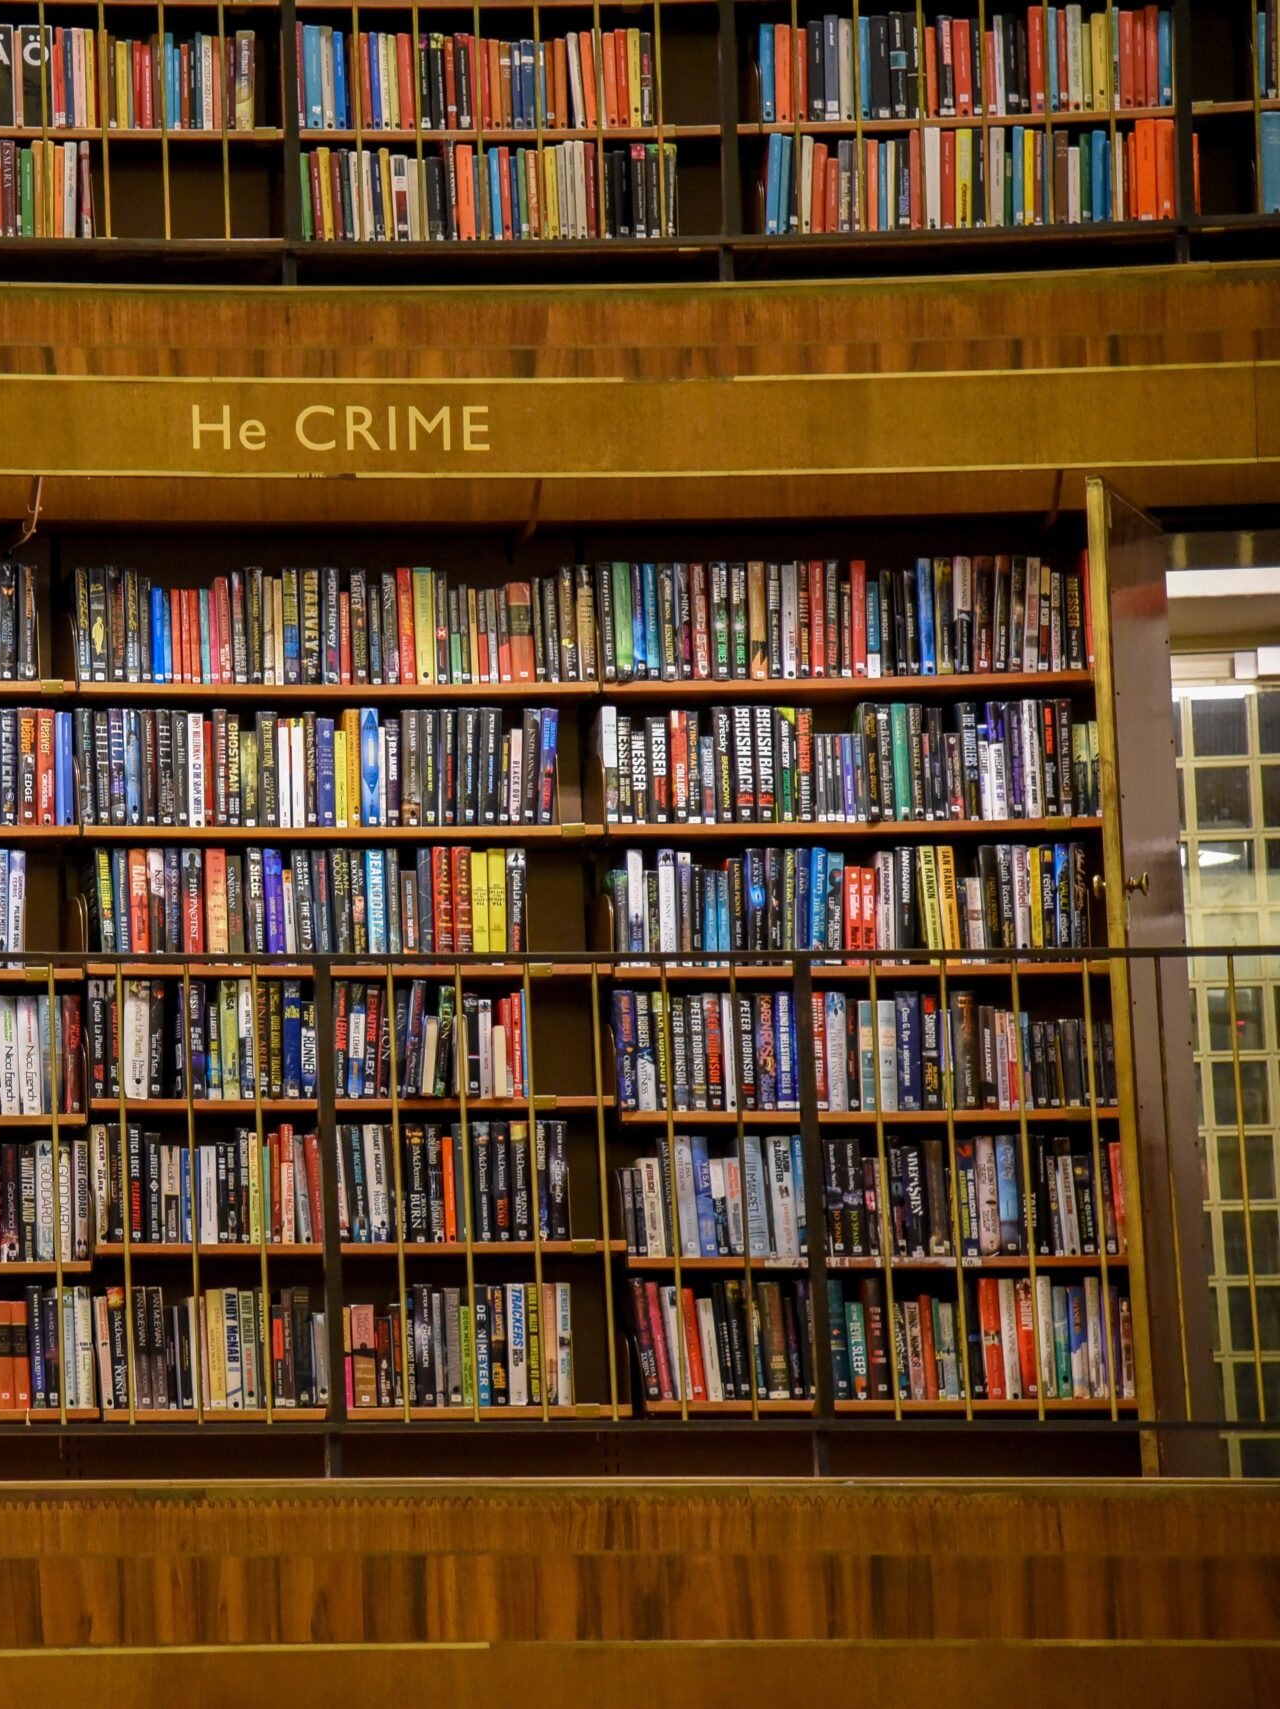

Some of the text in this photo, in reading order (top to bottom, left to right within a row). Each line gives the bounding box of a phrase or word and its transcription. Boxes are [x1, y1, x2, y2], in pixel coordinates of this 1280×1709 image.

[23, 34, 50, 66] Ö
[191, 404, 491, 451] He CRIME
[350, 574, 362, 609] HARVEY
[681, 593, 690, 622] MINA
[328, 578, 337, 647] John Harvey
[21, 718, 32, 753] Deaver
[40, 718, 51, 755] Deaver
[159, 725, 169, 768] HILL
[652, 730, 665, 776] NESSER
[757, 708, 773, 792] BRUSH BACK
[782, 738, 790, 768] PARETSKY
[964, 714, 976, 766] THE TRAVELERS
[229, 723, 239, 792] GHOSTMAN
[512, 760, 520, 787] BLACK
[632, 741, 645, 790] NESSER
[676, 763, 685, 807] COLLUSION
[721, 756, 730, 808] BREAKDOWN
[133, 865, 146, 896] RAGE
[250, 864, 260, 897] SIEGE
[333, 853, 343, 895] KOONTZ
[944, 868, 953, 899] RANKIN
[1043, 874, 1052, 909] rendell
[190, 884, 198, 939] HYPNOTIST
[300, 901, 310, 940] THE CITY
[93, 1001, 103, 1058] Lynda La Plante
[336, 1017, 347, 1050] LEHANE
[740, 1000, 754, 1084] PETER ROBINSON
[925, 1015, 936, 1048] SANDFORD
[303, 1036, 314, 1075] RUNNER
[366, 1046, 376, 1074] ALEX
[984, 1028, 992, 1083] BRILLIANCE
[130, 1129, 139, 1177] ATTICA LOCKE
[774, 1141, 783, 1183] SLAUGHTER
[21, 1157, 35, 1222] WINTERLAND
[701, 1162, 709, 1188] YRSA
[748, 1174, 757, 1212] MAIGRET
[410, 1194, 420, 1228] BURN
[225, 1293, 239, 1362] ANDY McNAB
[512, 1289, 523, 1347] TRACKERS
[478, 1344, 489, 1385] MEYER
[853, 1346, 865, 1374] SLEEP
